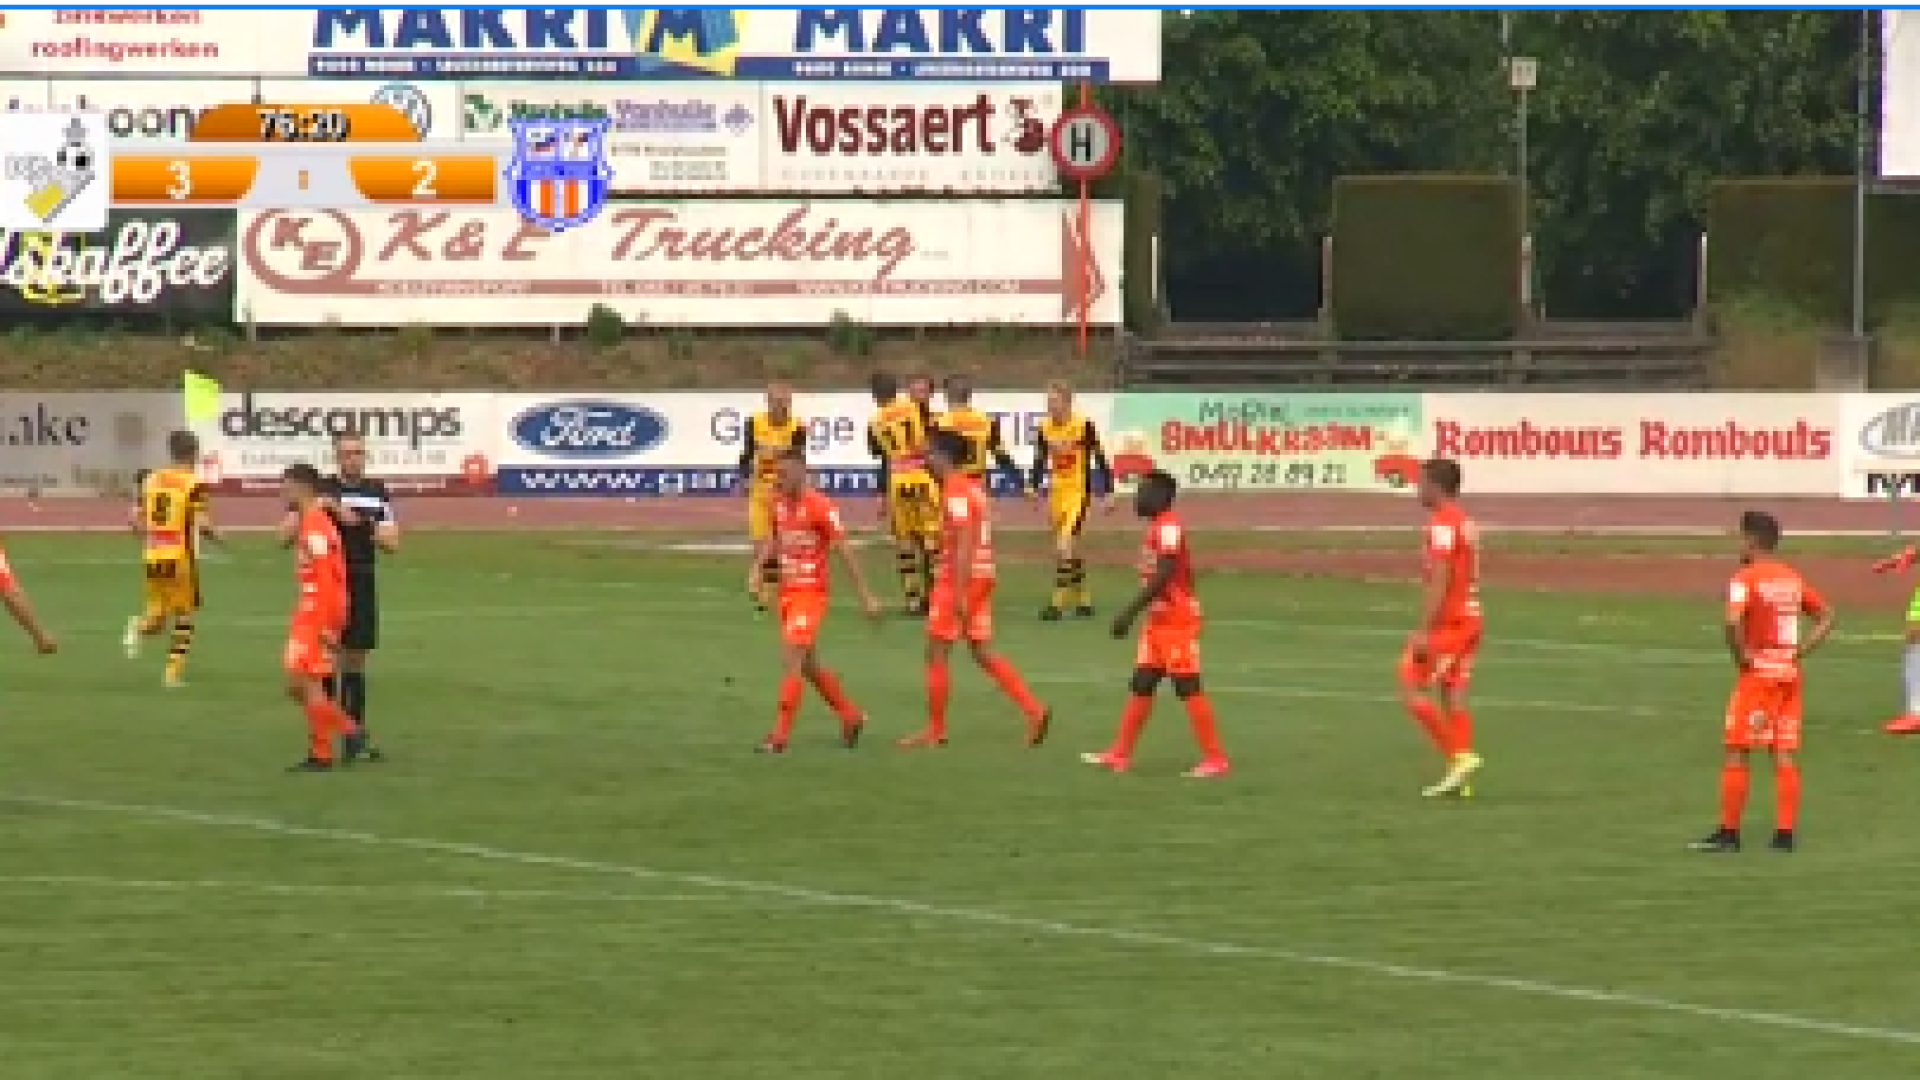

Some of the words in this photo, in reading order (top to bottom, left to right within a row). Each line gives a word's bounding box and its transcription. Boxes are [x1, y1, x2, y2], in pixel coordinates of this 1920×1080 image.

[32, 38, 219, 61] roofingwerken
[312, 9, 608, 49] MAKRI
[793, 9, 1086, 53] MAKRI
[772, 94, 997, 154] Vossaert
[1069, 129, 1092, 161] H
[378, 212, 449, 261] K
[441, 216, 486, 261] &
[611, 204, 916, 289] Trucking
[221, 393, 464, 449] descamps
[540, 407, 638, 448] Ford
[1433, 417, 1623, 460] Rombouts
[1640, 416, 1831, 460] Rombouts
